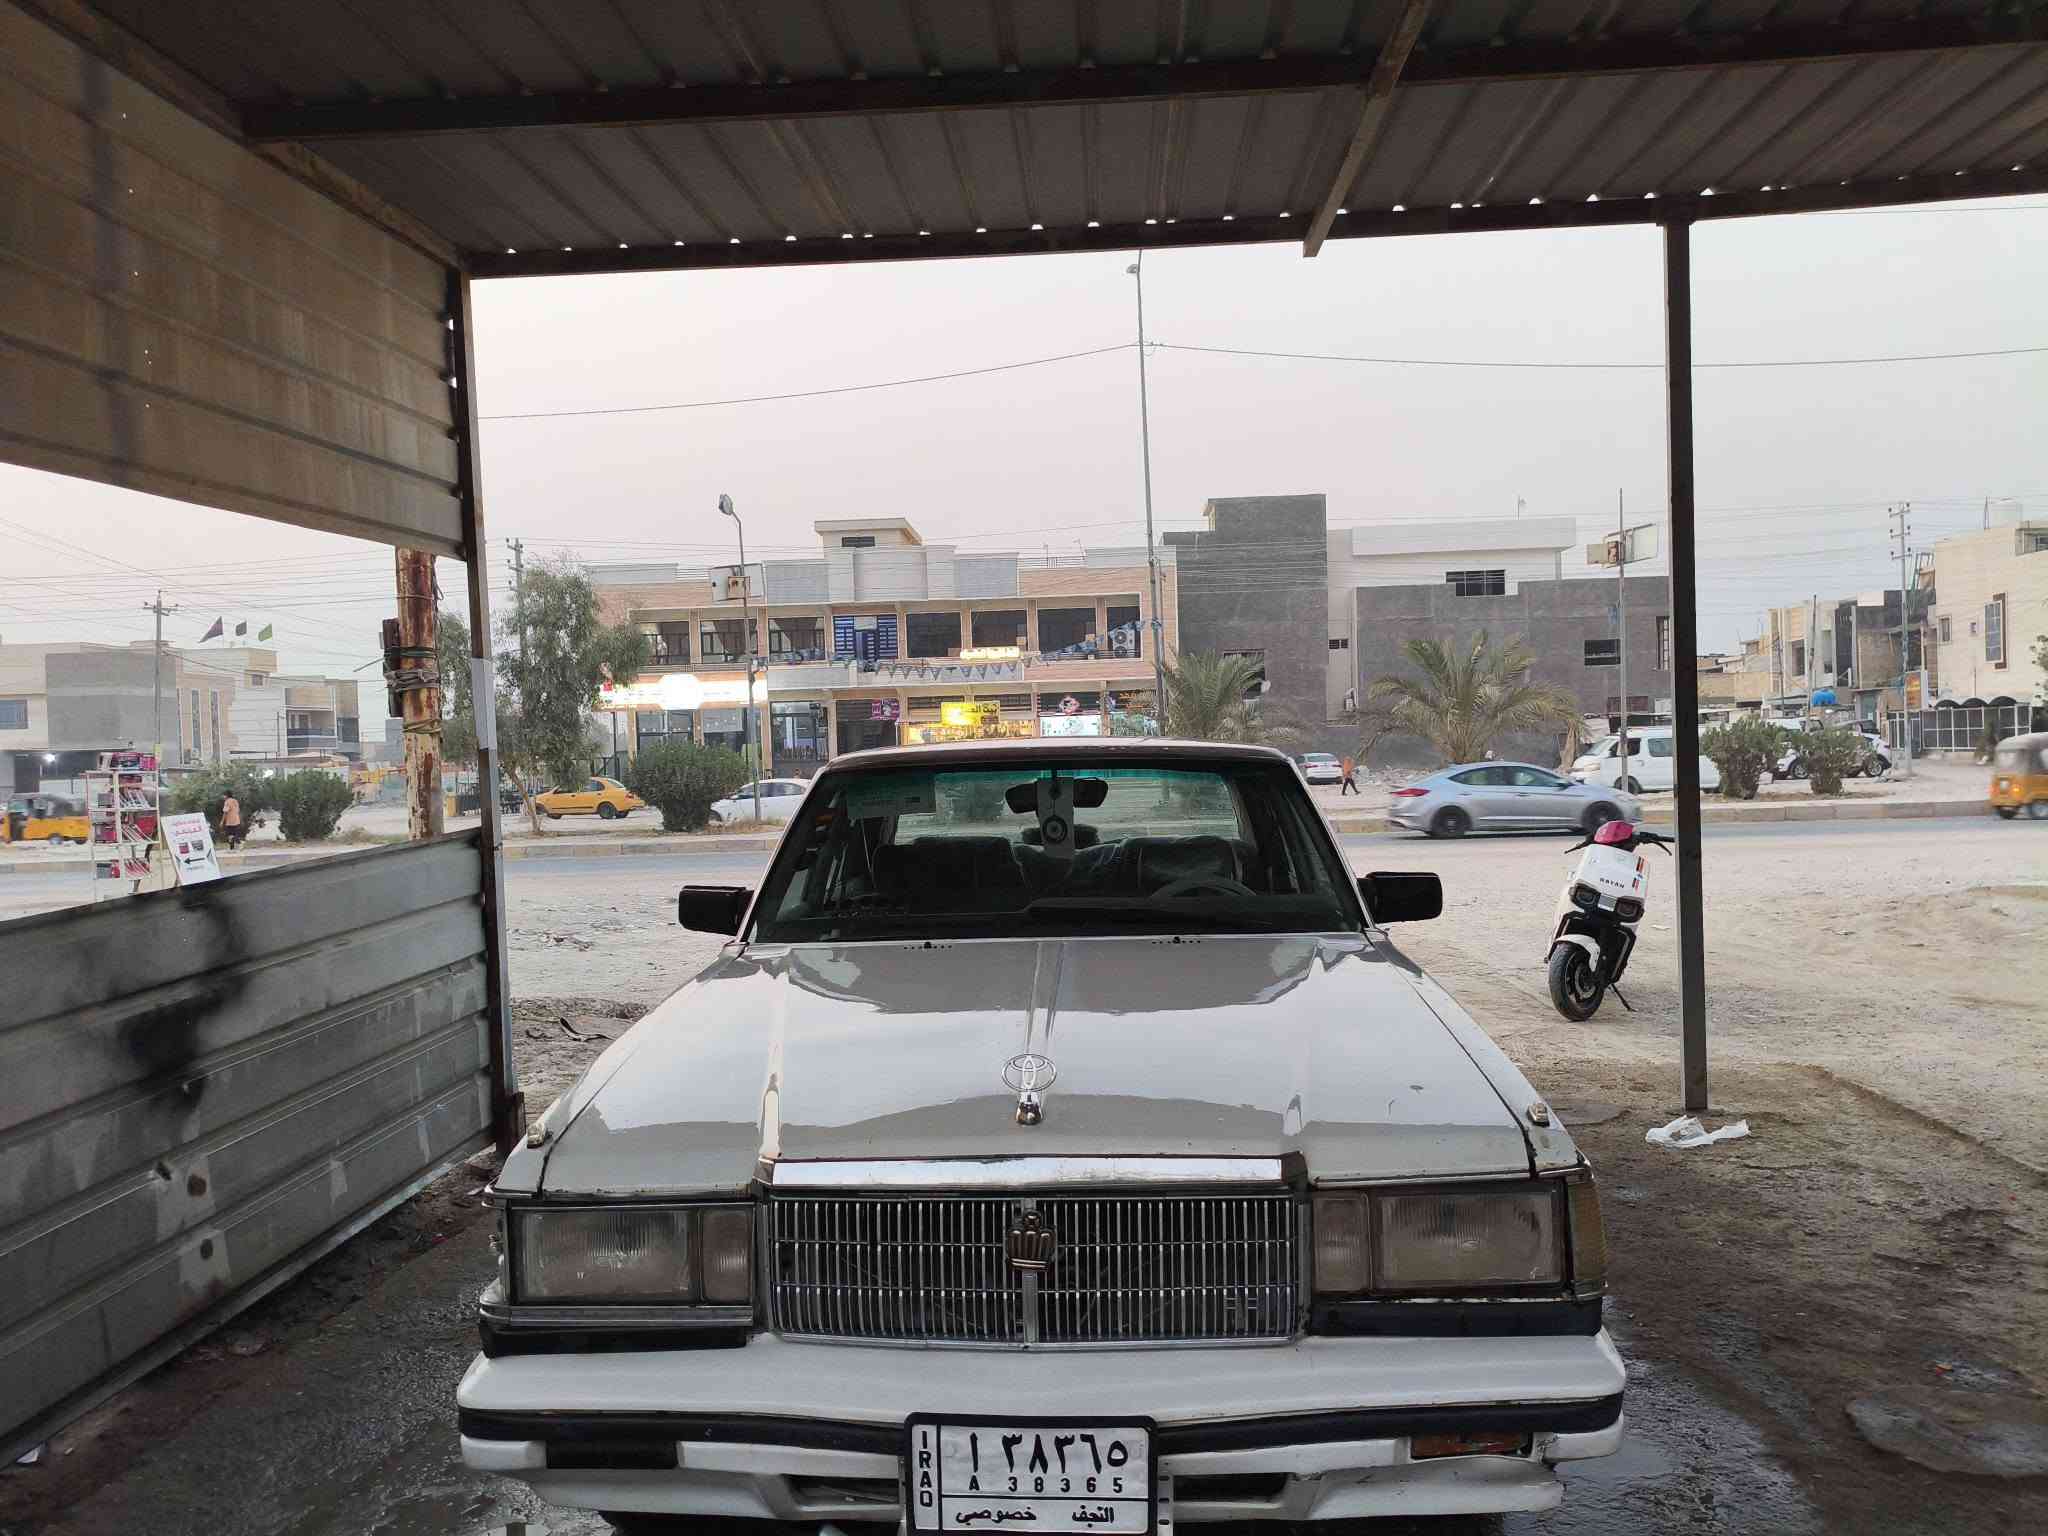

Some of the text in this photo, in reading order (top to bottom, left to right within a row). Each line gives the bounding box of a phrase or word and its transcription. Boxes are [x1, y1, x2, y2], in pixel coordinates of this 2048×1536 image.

[918, 1430, 933, 1508] IRAQ
[955, 1504, 1115, 1528] النجف خصوصي
